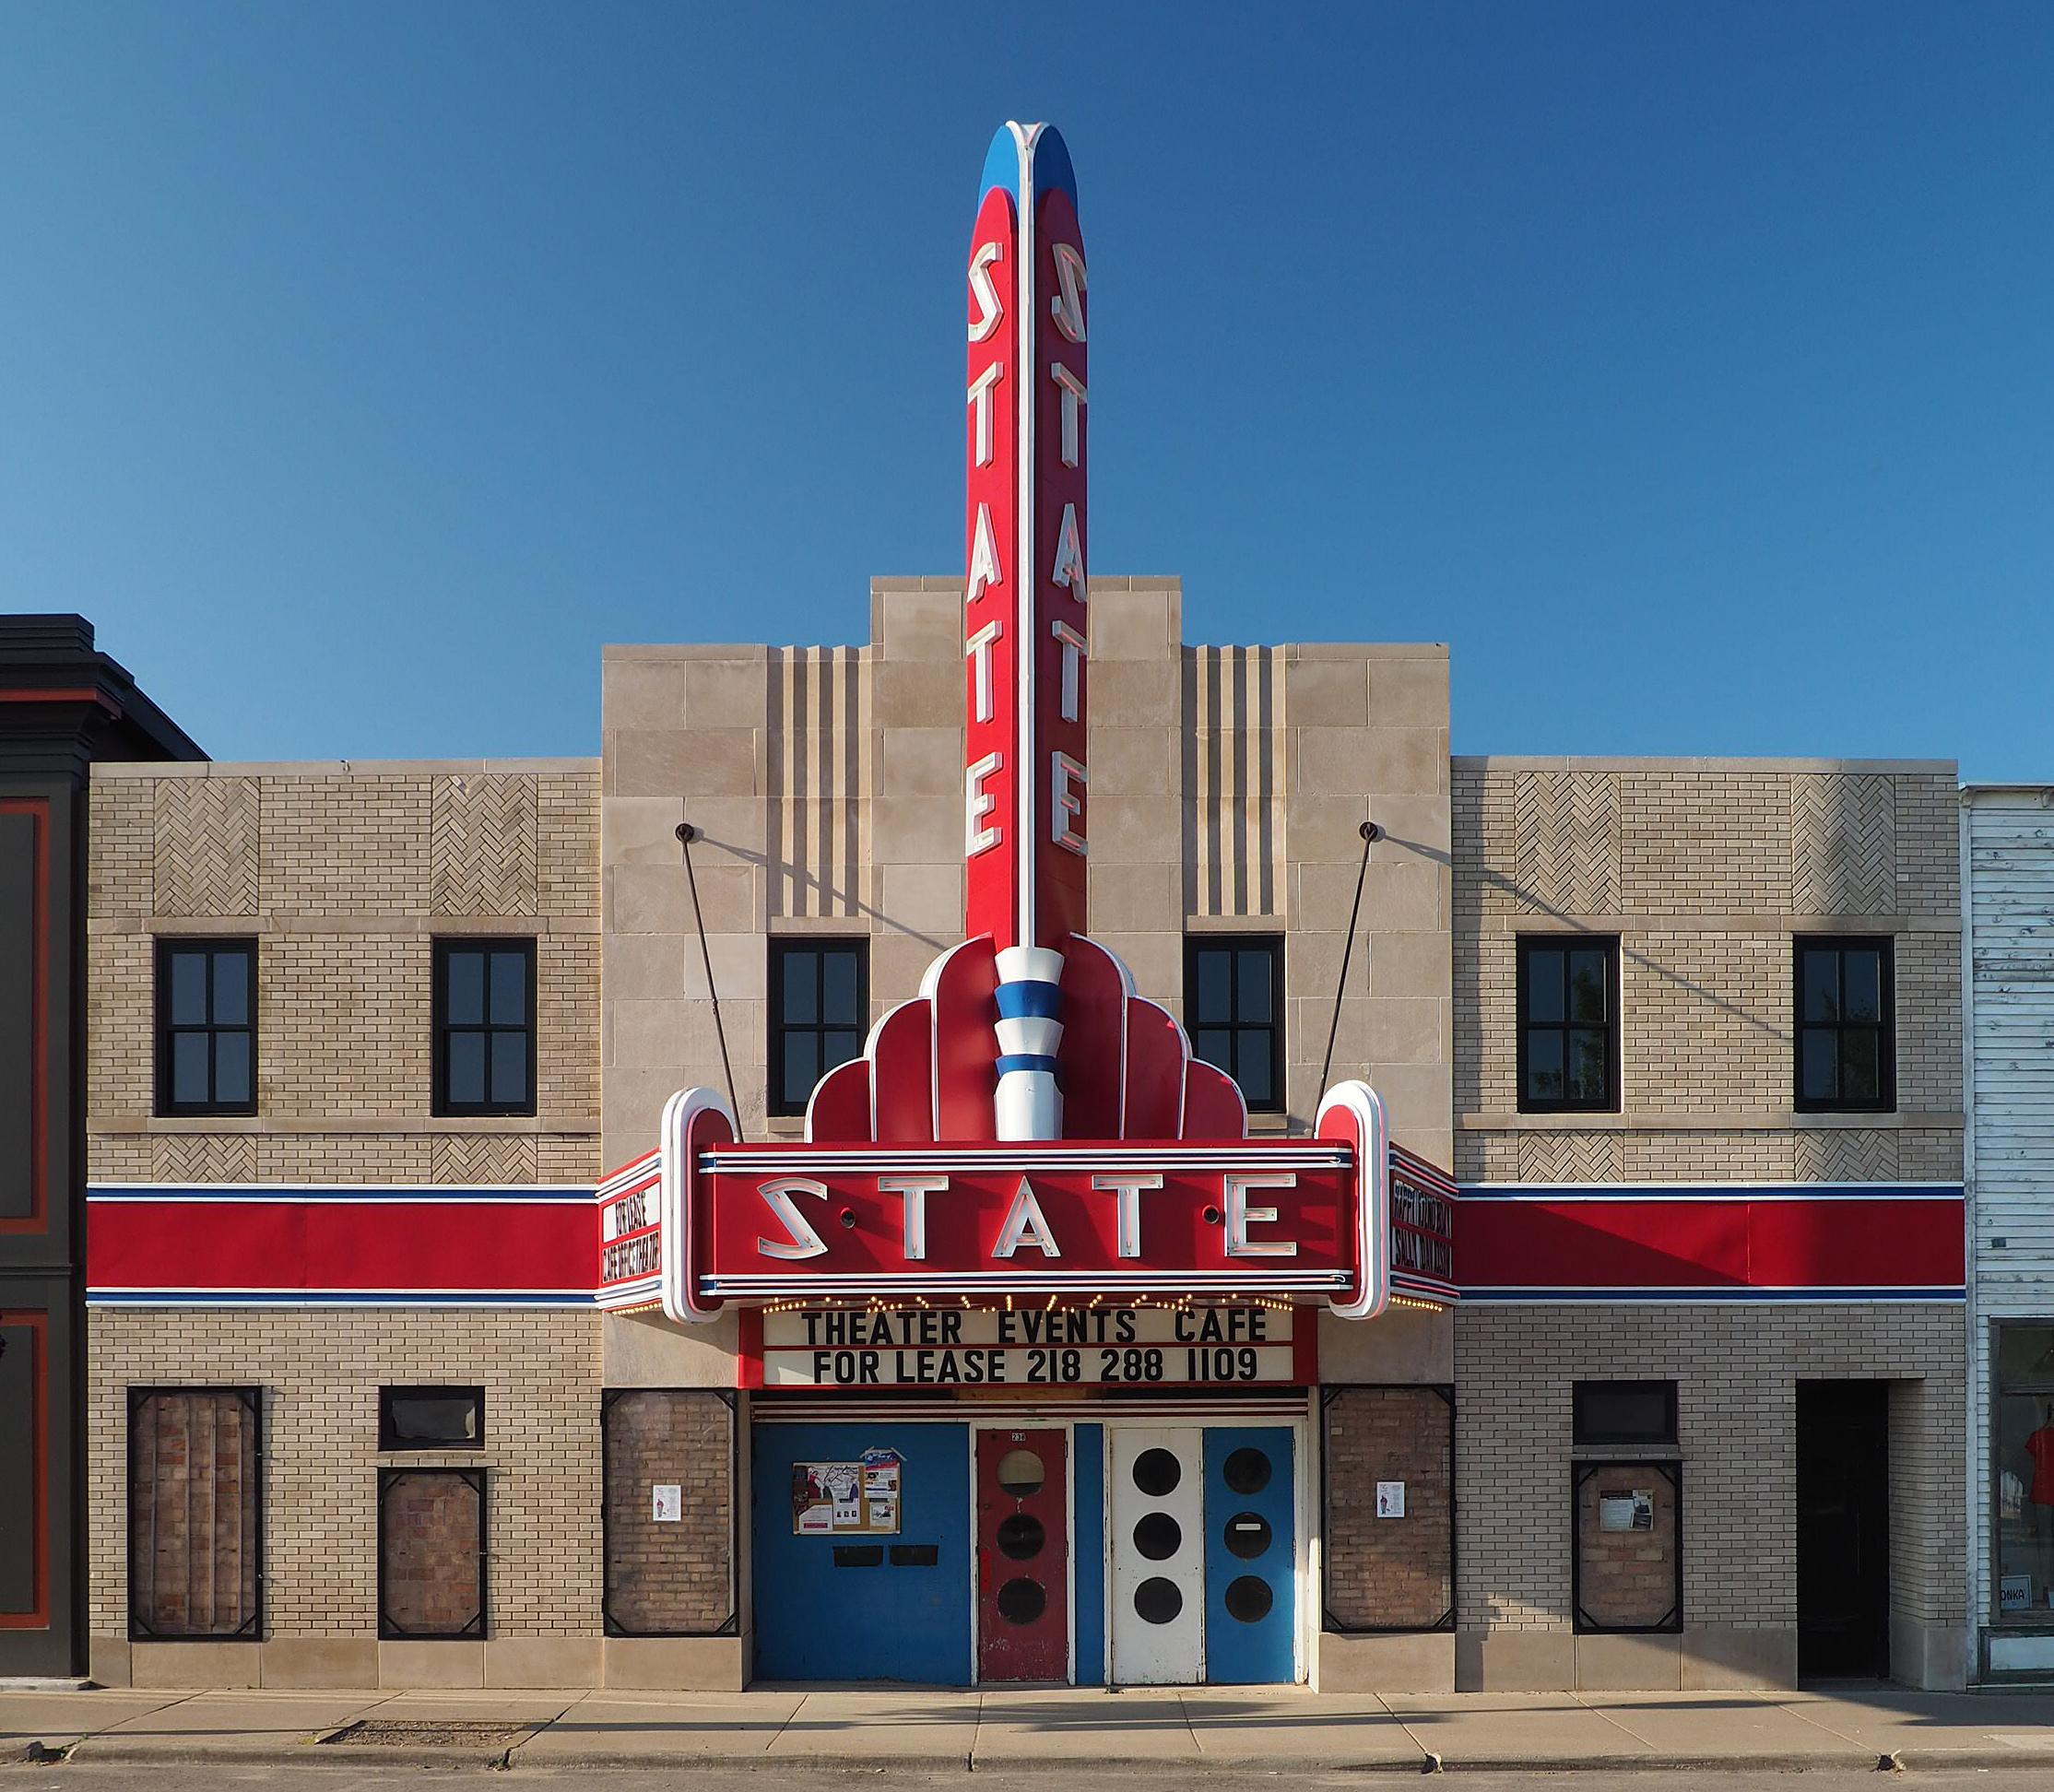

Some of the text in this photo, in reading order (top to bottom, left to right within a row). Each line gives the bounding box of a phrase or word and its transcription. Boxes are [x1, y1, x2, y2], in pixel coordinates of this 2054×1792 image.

[966, 242, 1004, 856] STATE
[1052, 242, 1088, 856] STATE
[757, 1173, 1297, 1260] STATE
[801, 1309, 1267, 1345] THEATER EVENTS CAFE
[813, 1348, 1257, 1384] FOR LEASE 218 288 1109
